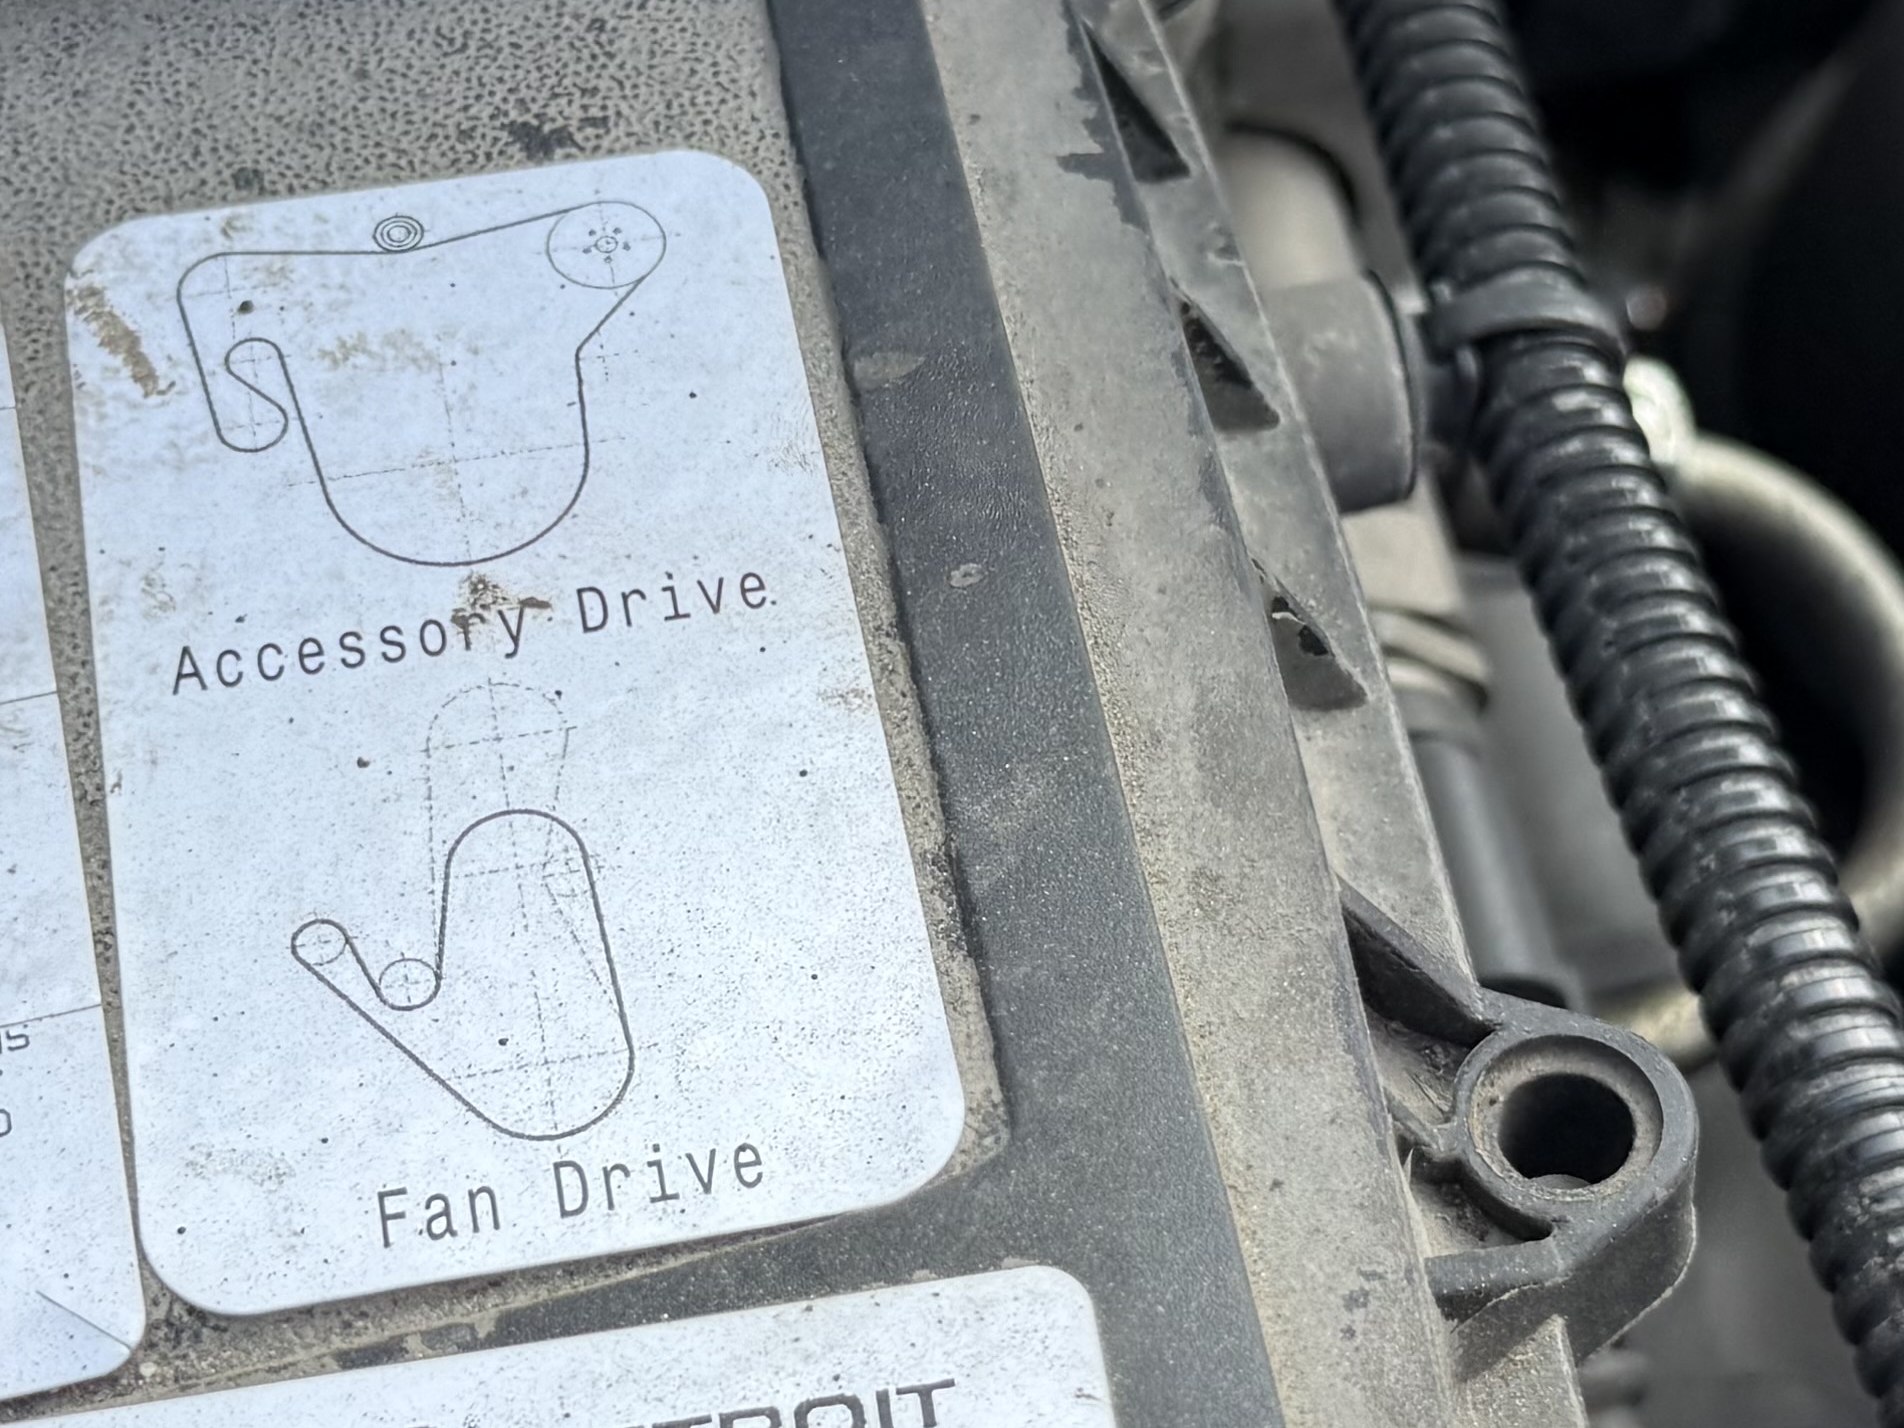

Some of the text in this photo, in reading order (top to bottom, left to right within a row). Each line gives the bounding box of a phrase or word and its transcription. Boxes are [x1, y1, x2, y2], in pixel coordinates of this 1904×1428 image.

[170, 567, 770, 695] Accessory Drive
[378, 1137, 765, 1248] Fan Drive
